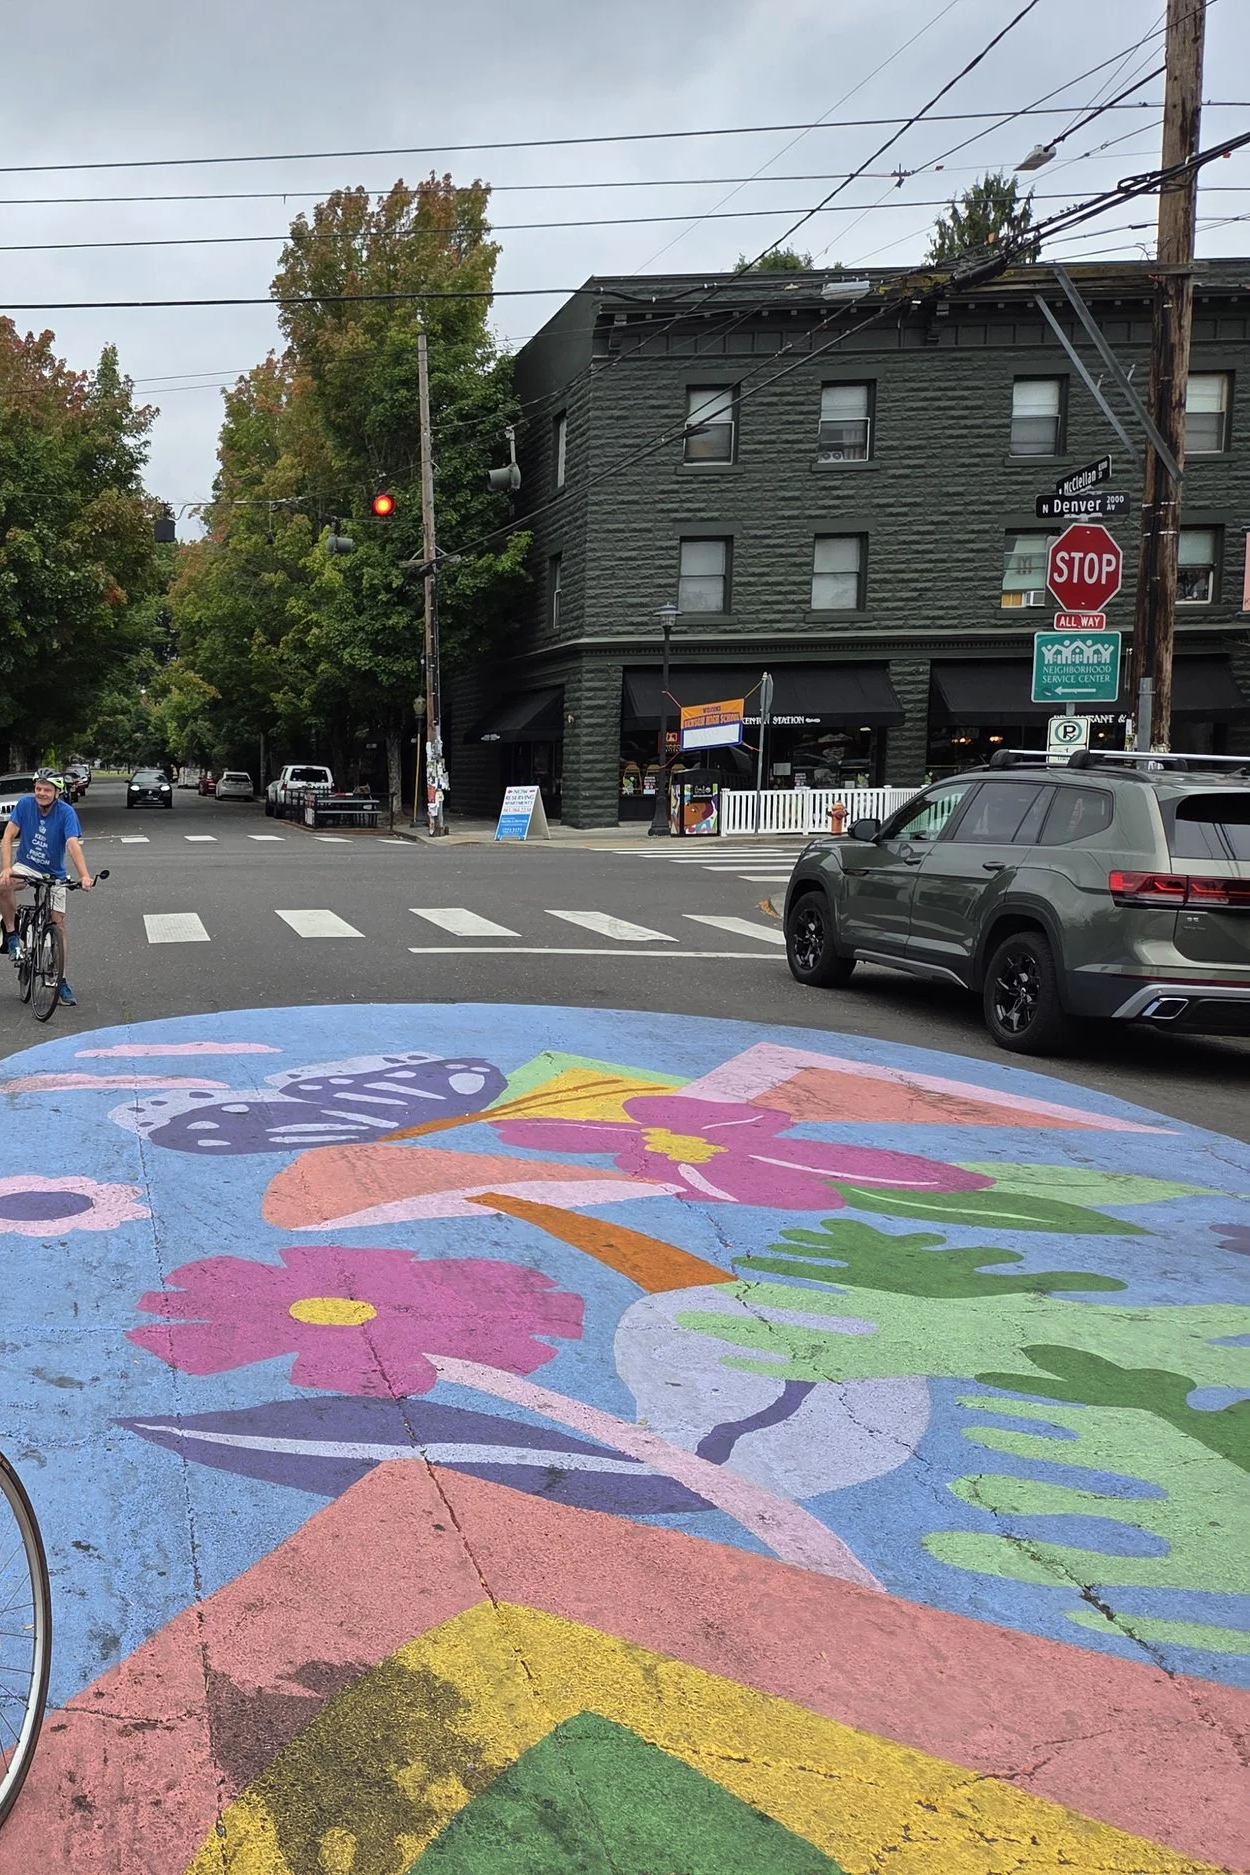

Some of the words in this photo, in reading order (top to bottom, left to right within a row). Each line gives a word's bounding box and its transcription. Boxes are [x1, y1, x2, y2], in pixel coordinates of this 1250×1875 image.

[1063, 470, 1096, 494] McClellan
[1042, 504, 1049, 514] N
[1053, 499, 1101, 513] Denver
[1106, 495, 1125, 503] 2000
[1053, 551, 1117, 585] STOP
[1059, 616, 1078, 627] ALL
[1080, 616, 1101, 627] WAY
[1043, 665, 1112, 674] NEIGHBORHOOD
[1042, 675, 1076, 683] SERVICE
[1079, 675, 1111, 683] CENTER
[772, 716, 805, 725] STATION
[31, 838, 49, 848] CALM
